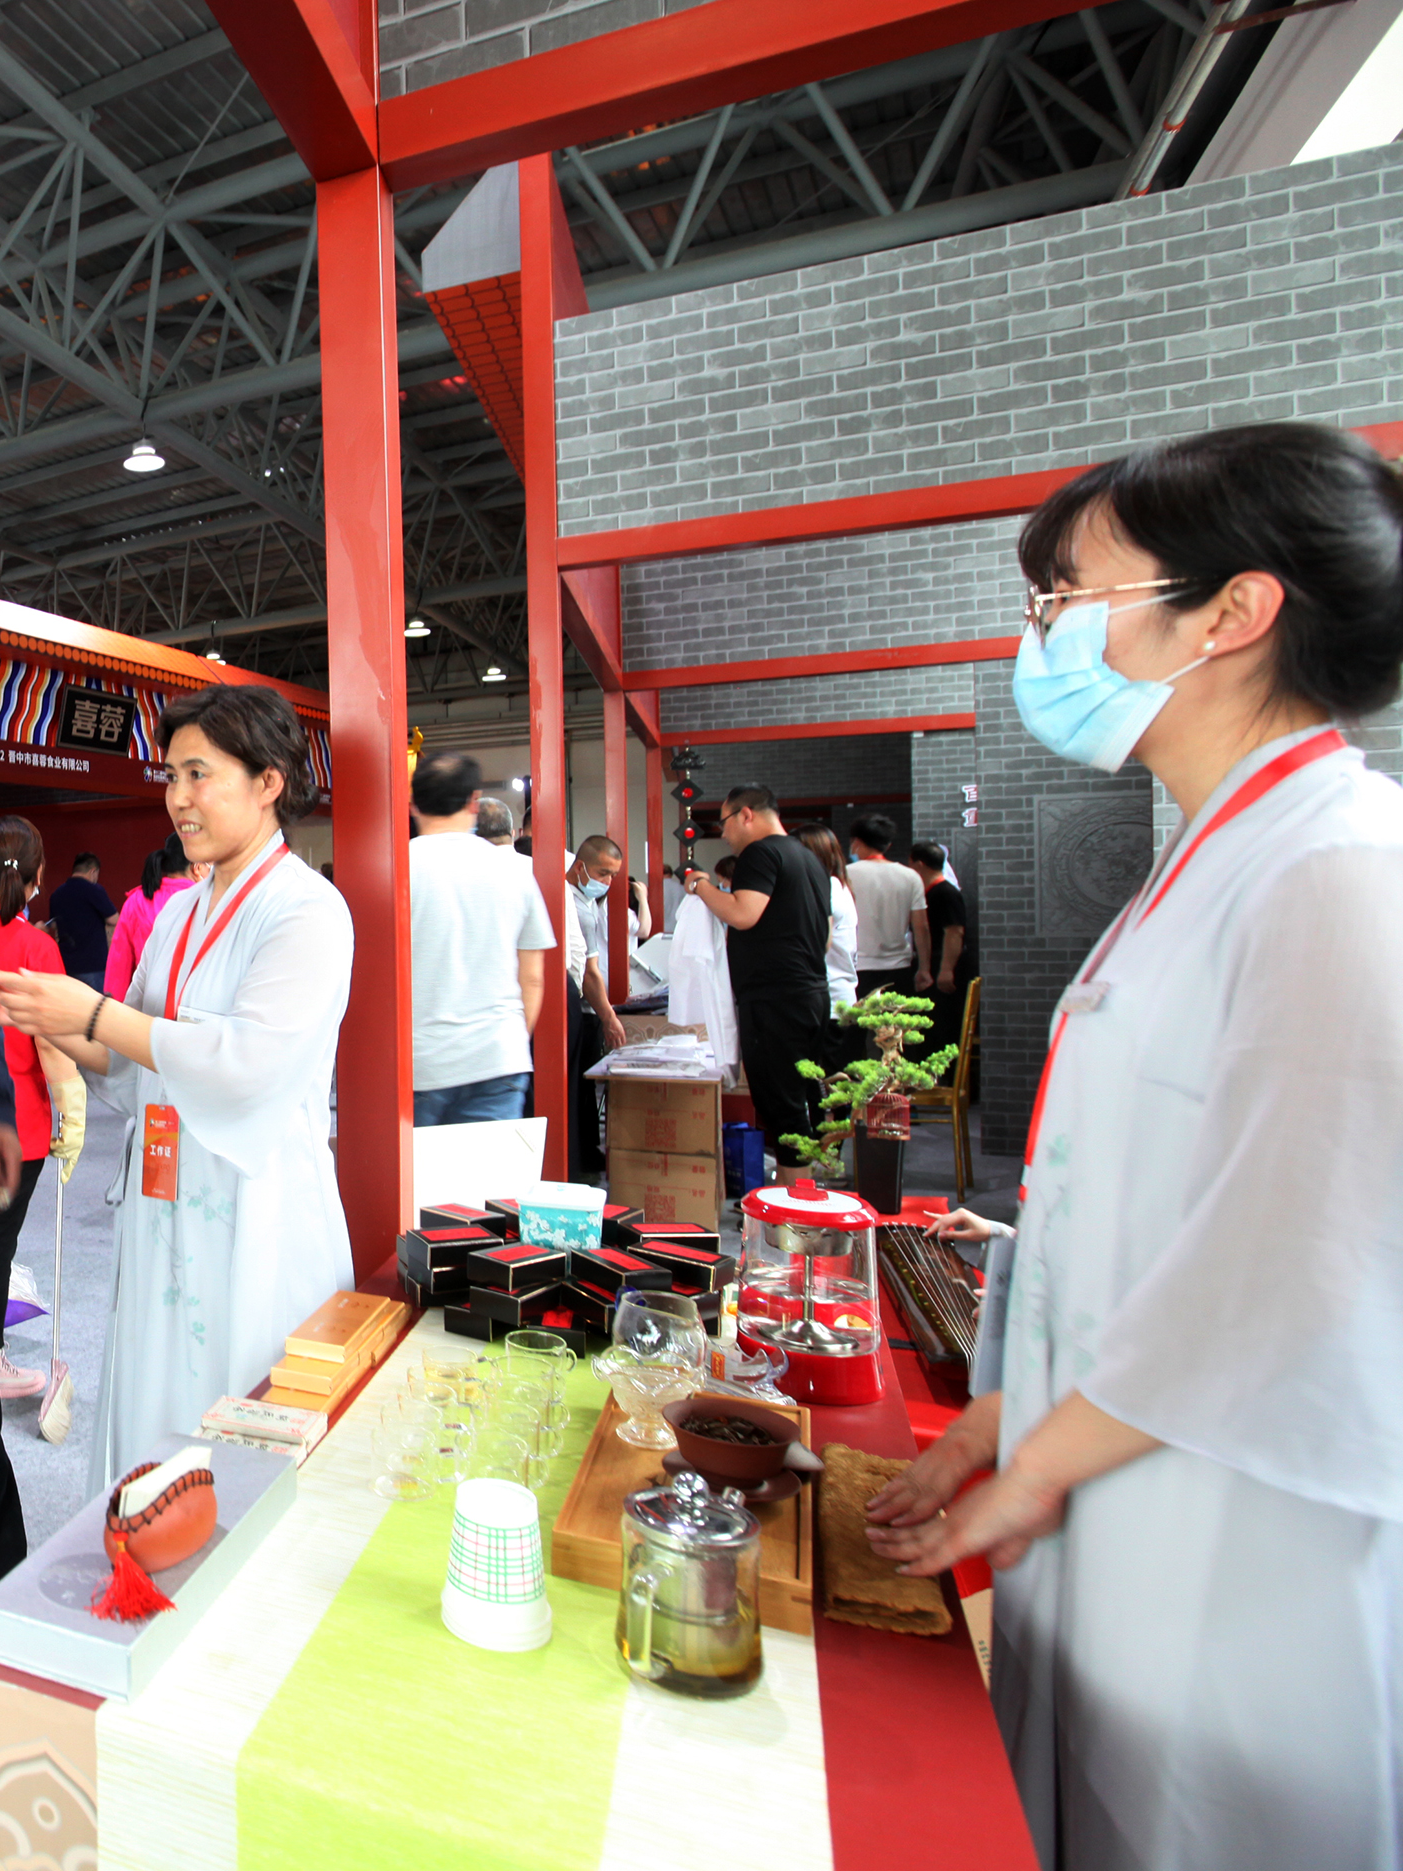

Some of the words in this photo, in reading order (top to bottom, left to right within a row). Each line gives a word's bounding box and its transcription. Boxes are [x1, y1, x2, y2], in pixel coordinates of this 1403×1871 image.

[71, 699, 126, 744] 喜蓉
[150, 1144, 172, 1158] 工作证
